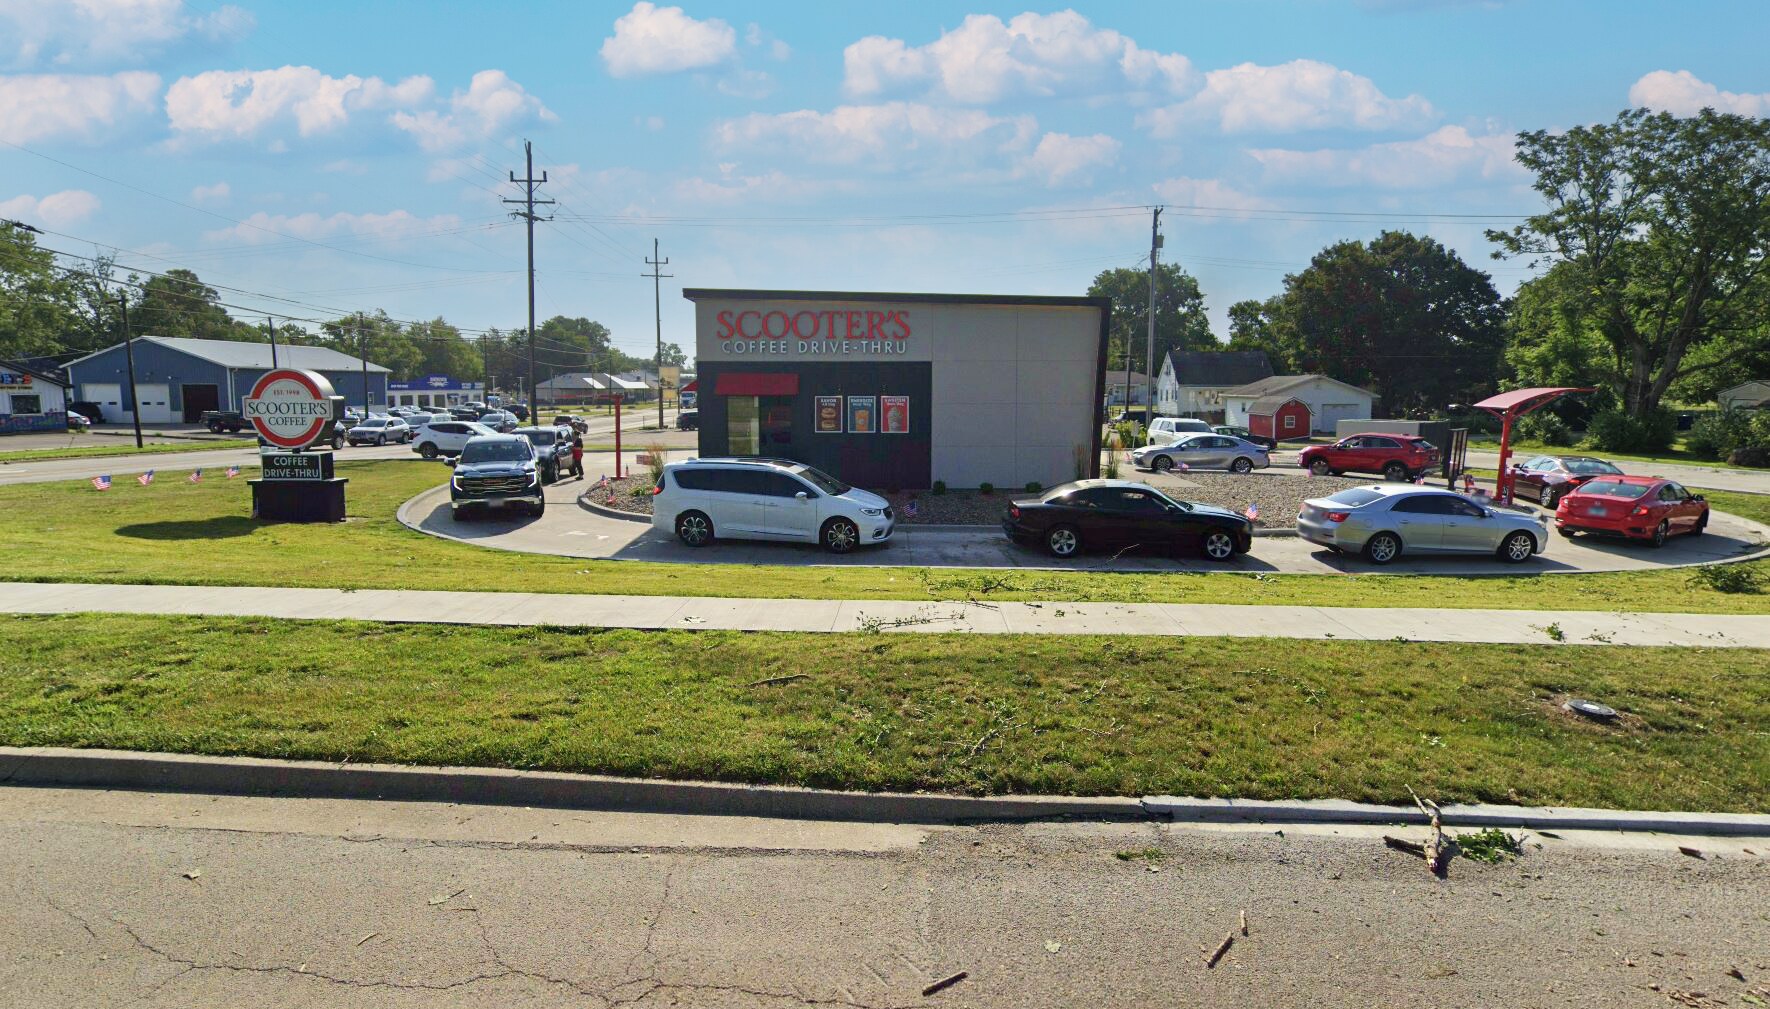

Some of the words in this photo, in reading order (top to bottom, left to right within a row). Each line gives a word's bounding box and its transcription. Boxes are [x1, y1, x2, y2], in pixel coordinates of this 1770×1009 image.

[716, 310, 911, 340] SCOOTER'S
[722, 341, 787, 353] COFFEE
[798, 341, 906, 354] DRIVE-THRU
[248, 401, 327, 415] SCOOTER'S
[268, 416, 307, 426] COFFEE
[273, 456, 308, 466] COFFEE
[264, 468, 319, 478] DRIVE-THRU
